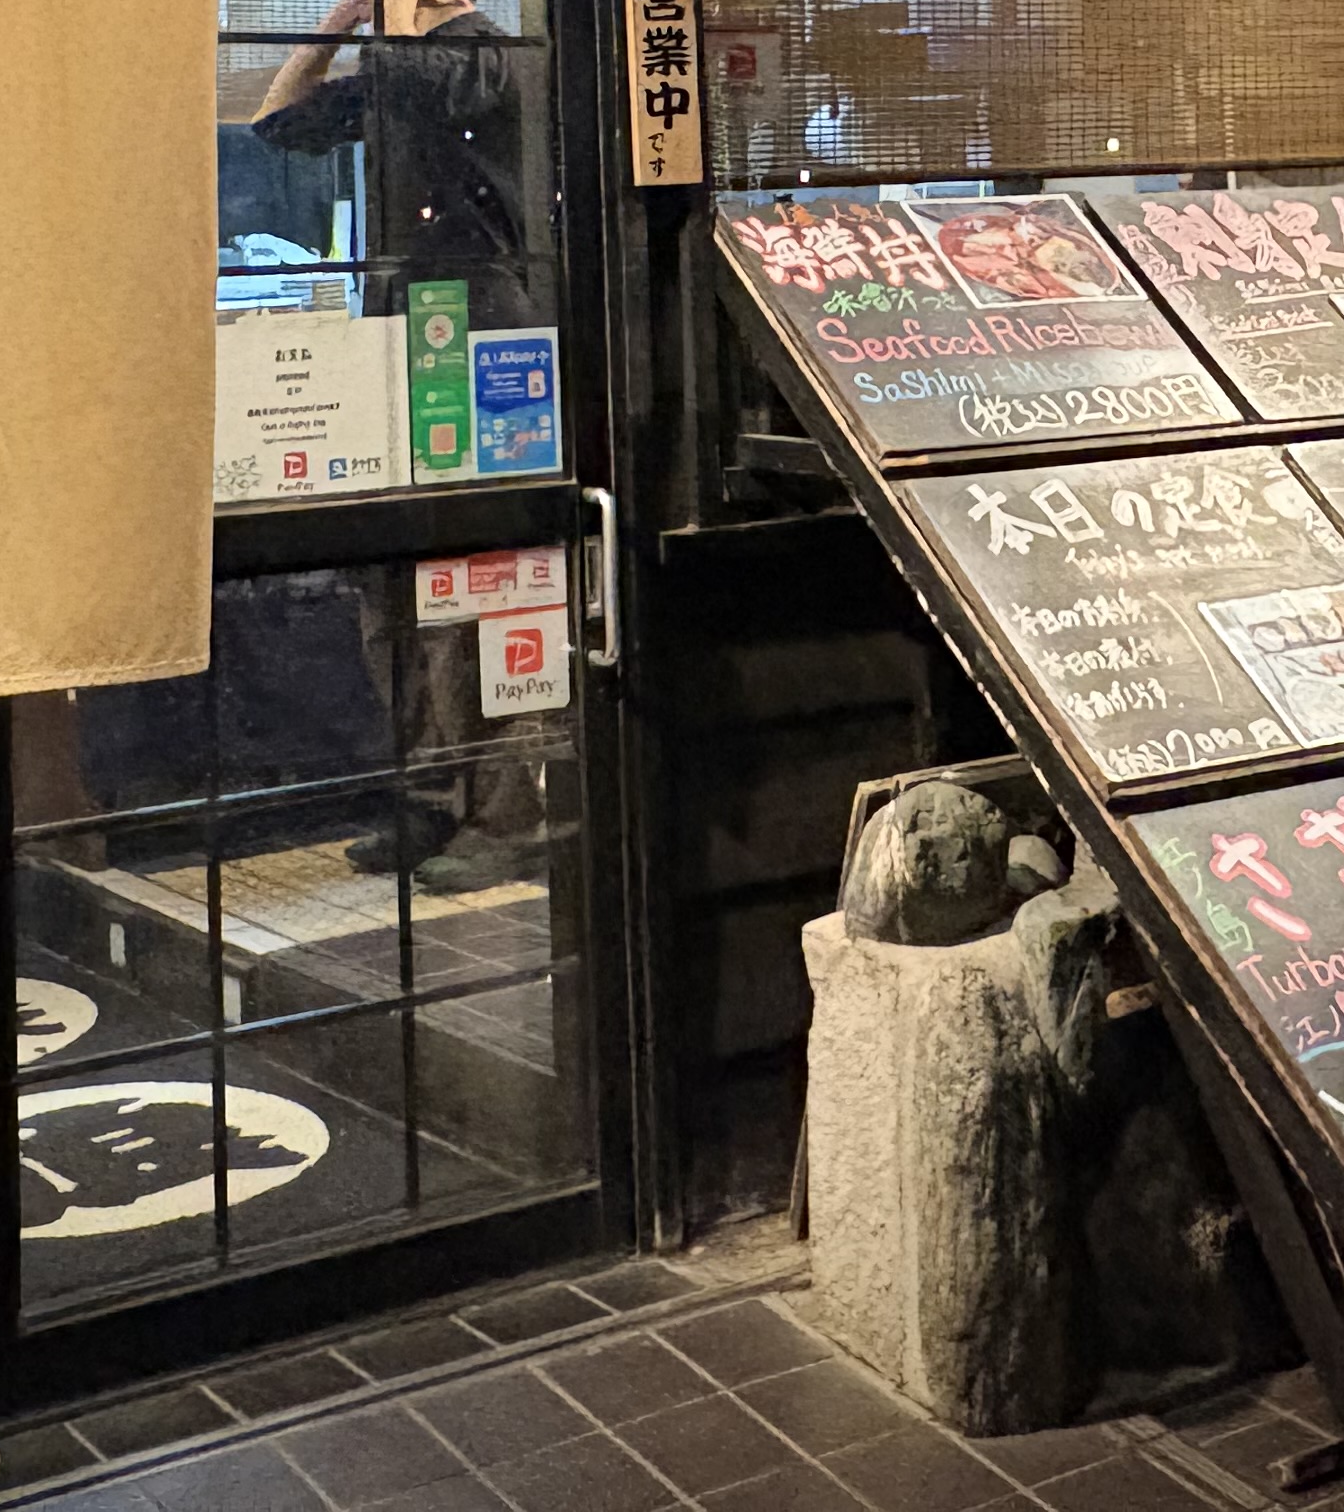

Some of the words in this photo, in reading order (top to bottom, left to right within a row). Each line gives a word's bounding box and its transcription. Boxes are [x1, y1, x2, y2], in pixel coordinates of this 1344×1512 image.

[732, 216, 950, 293] 海鮮丼
[966, 464, 1278, 555] 本日の定食
